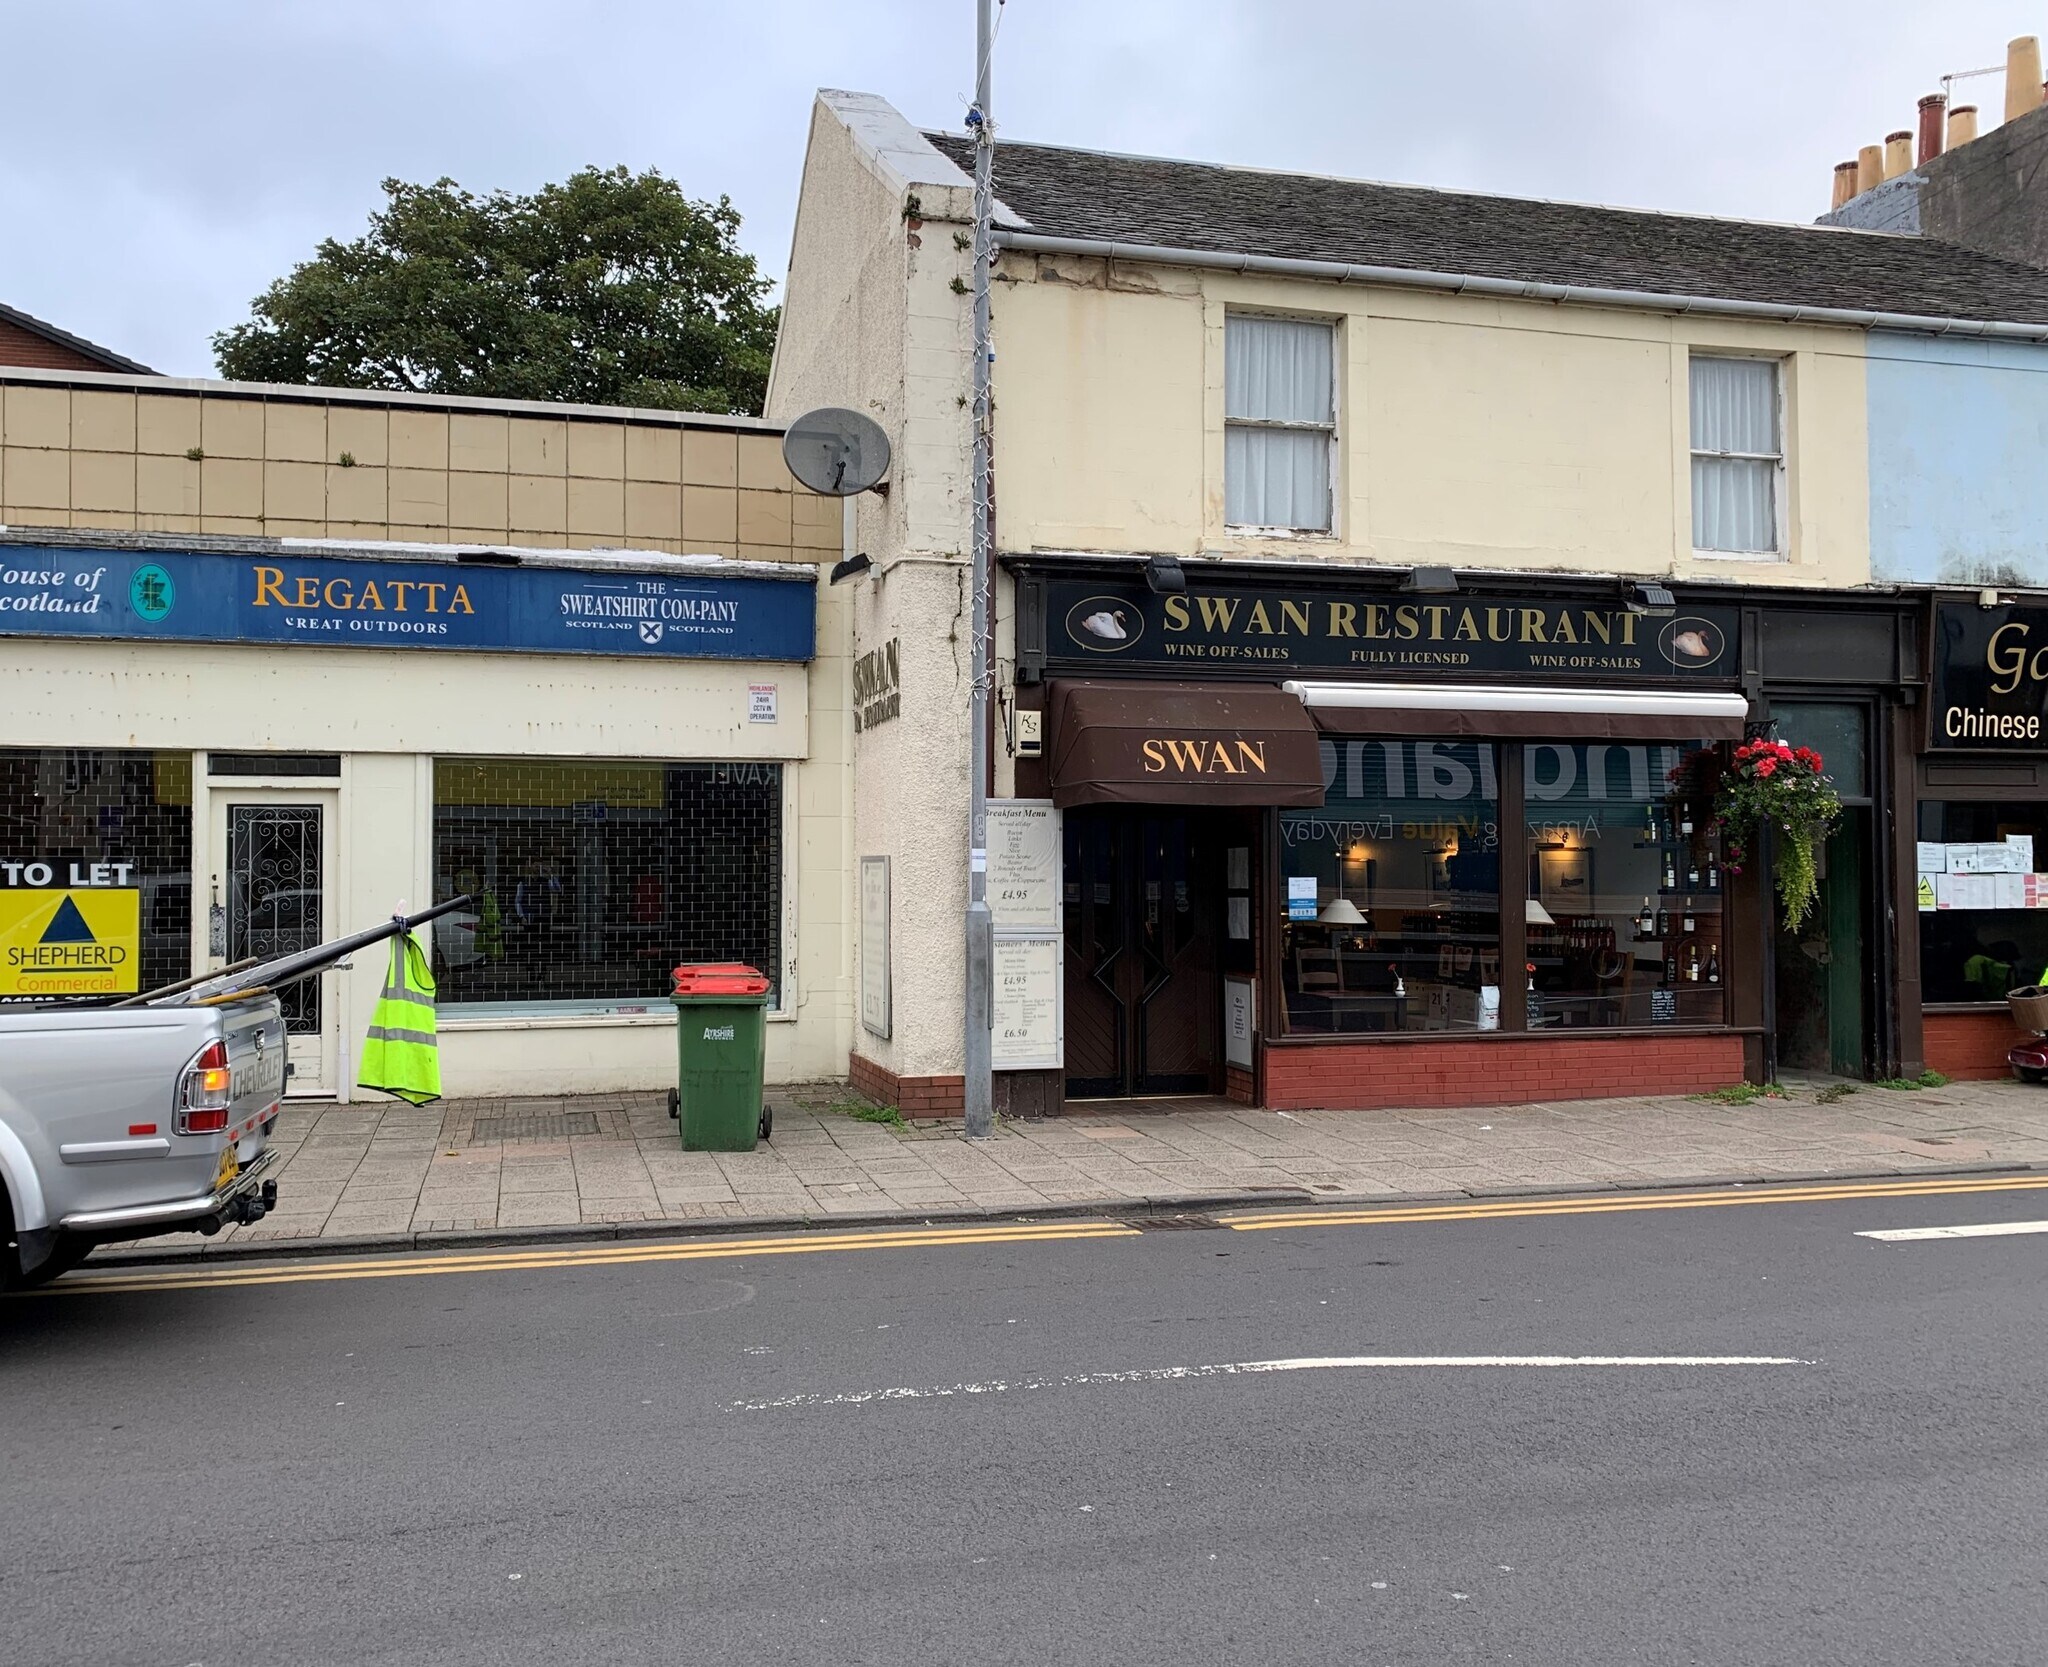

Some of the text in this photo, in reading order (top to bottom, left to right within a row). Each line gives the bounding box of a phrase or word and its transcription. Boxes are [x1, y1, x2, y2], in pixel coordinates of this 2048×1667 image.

[0, 564, 107, 592] ouse of
[252, 566, 475, 614] REGATTA
[636, 581, 667, 595] THE
[560, 593, 658, 619] SWEATSHIRT
[350, 619, 448, 634] OUTDOORS
[565, 621, 734, 634] SCOTLAND SCOTLAND
[1163, 594, 1642, 645] SWAN RESTAURANT
[1164, 643, 1290, 660] WINE OFF-SALES
[1351, 650, 1470, 665] FULLY LICENSED
[1529, 654, 1641, 669] WINE OFF-SALES
[853, 637, 899, 705] SWAN
[1946, 706, 2040, 739] Chinese
[1142, 739, 1268, 774] SWAN
[985, 809, 1047, 819] Breakfast Menu
[1, 862, 133, 886] TO LET
[1002, 889, 1028, 900] £4.95
[8, 946, 126, 966] SHEPHERD
[16, 975, 118, 992] Commercial
[703, 1028, 735, 1040] AYRSHIRE
[1004, 1028, 1028, 1038] £6.50
[233, 1053, 282, 1102] CHEVROLET
